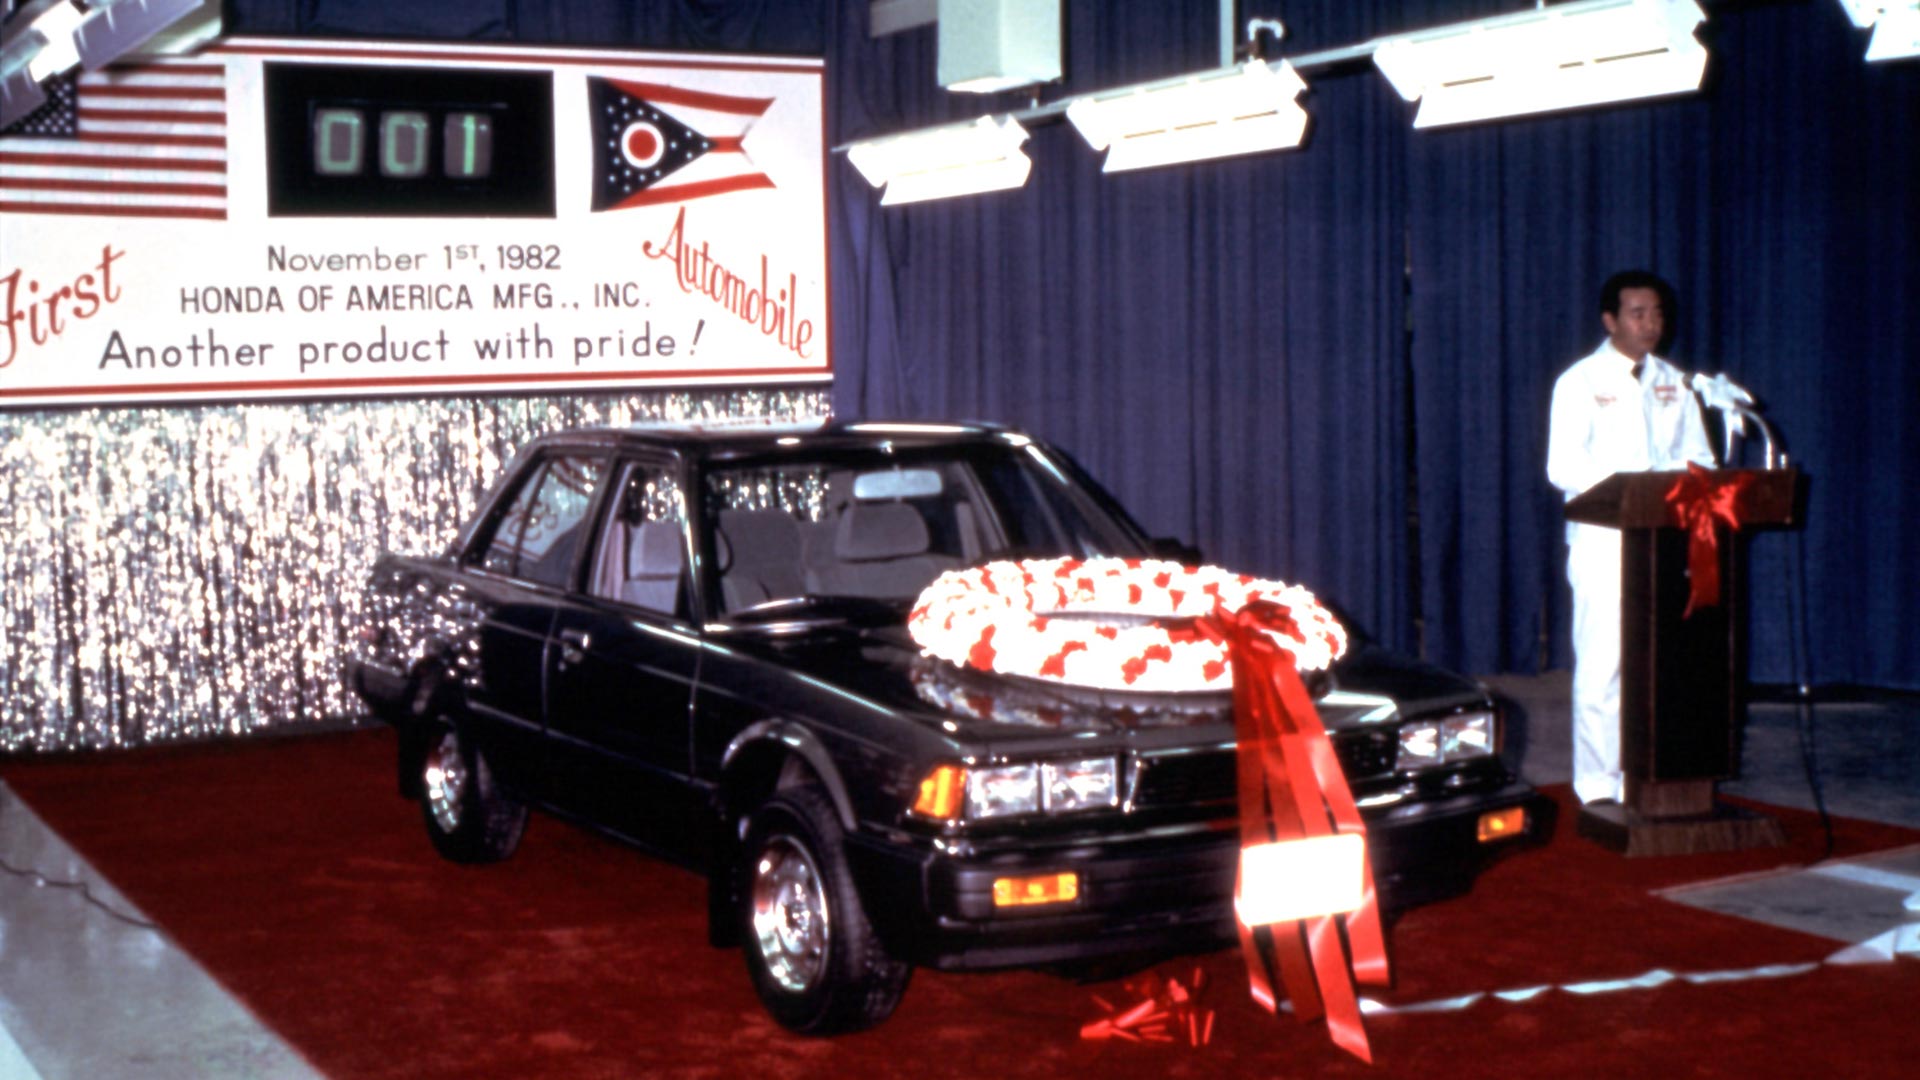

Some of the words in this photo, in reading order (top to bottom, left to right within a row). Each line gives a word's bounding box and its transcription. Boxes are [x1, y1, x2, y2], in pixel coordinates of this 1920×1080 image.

[318, 111, 478, 176] 001
[268, 246, 426, 271] November
[444, 245, 485, 271] 1ST,
[498, 245, 560, 270] 1982
[642, 206, 812, 358] Automobile
[181, 286, 284, 314] HONDA
[298, 285, 333, 312] OF
[346, 284, 473, 311] AMERICA
[595, 282, 649, 307] INC.
[99, 328, 273, 369] Another
[299, 325, 449, 373] product
[474, 323, 553, 360] with
